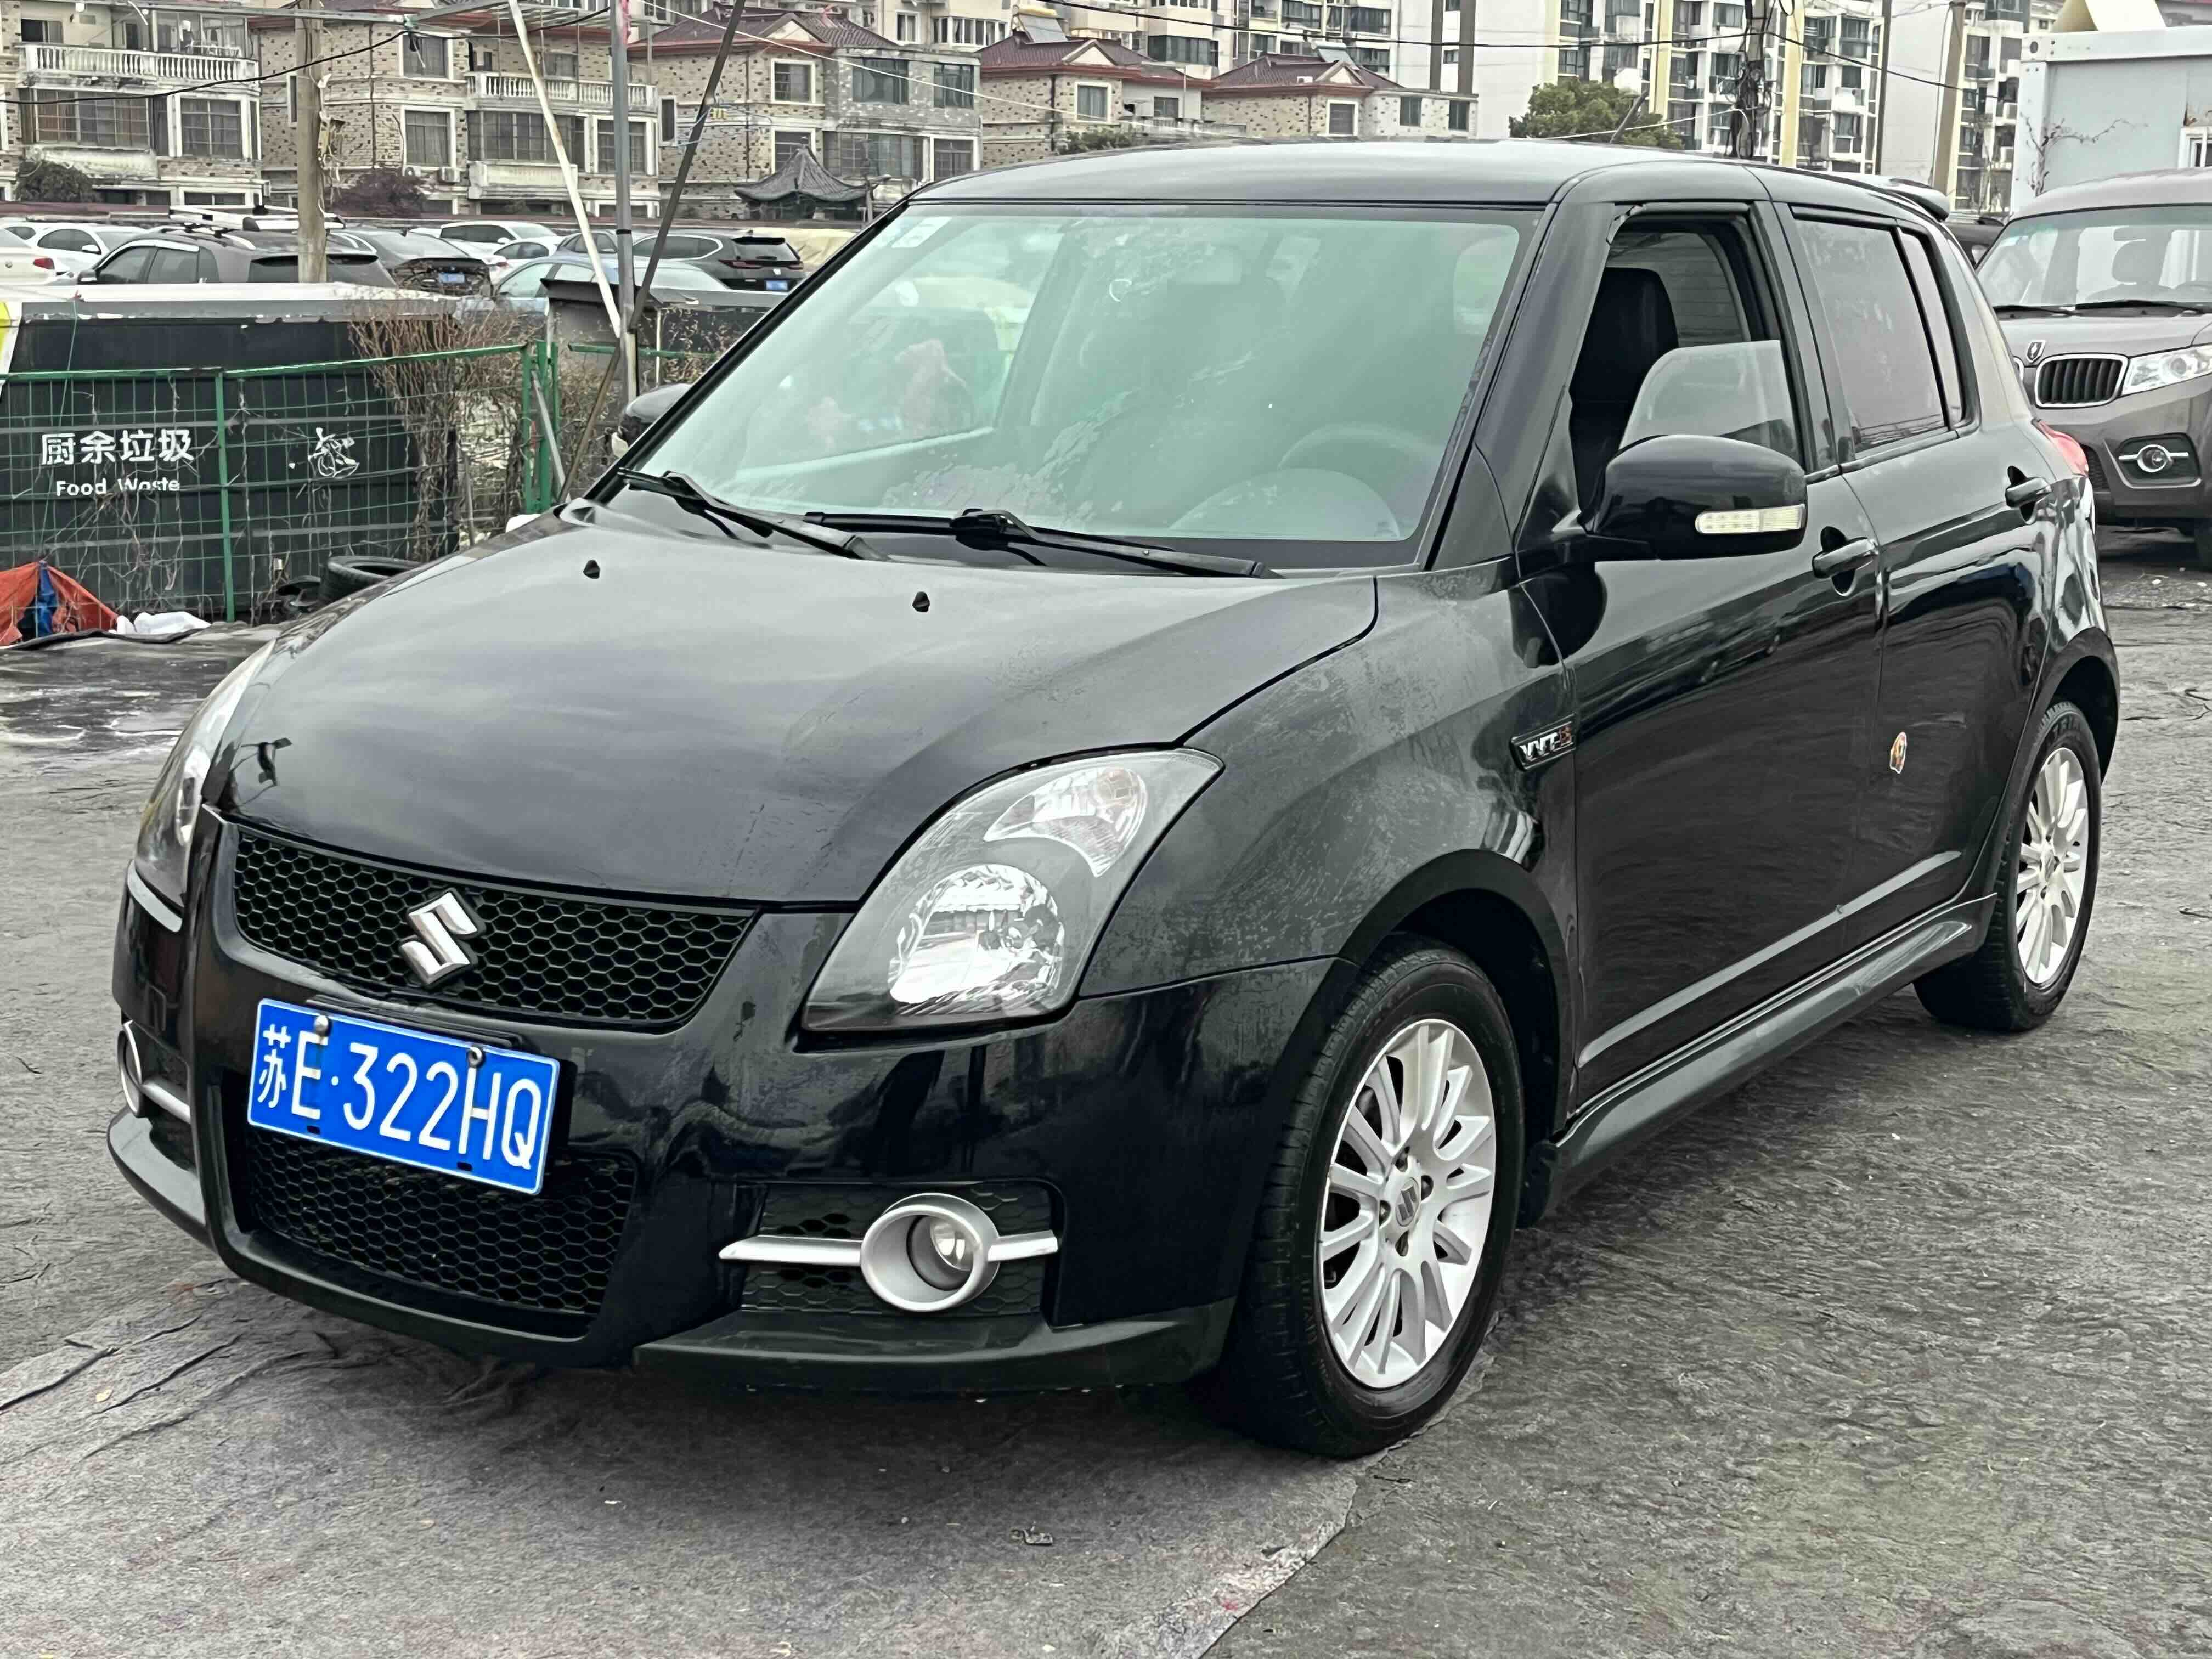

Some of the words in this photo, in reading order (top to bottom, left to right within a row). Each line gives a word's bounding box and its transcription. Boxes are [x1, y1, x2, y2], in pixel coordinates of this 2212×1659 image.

[41, 428, 194, 465] 厨余垃圾
[55, 478, 107, 496] Food
[117, 477, 180, 492] Waste
